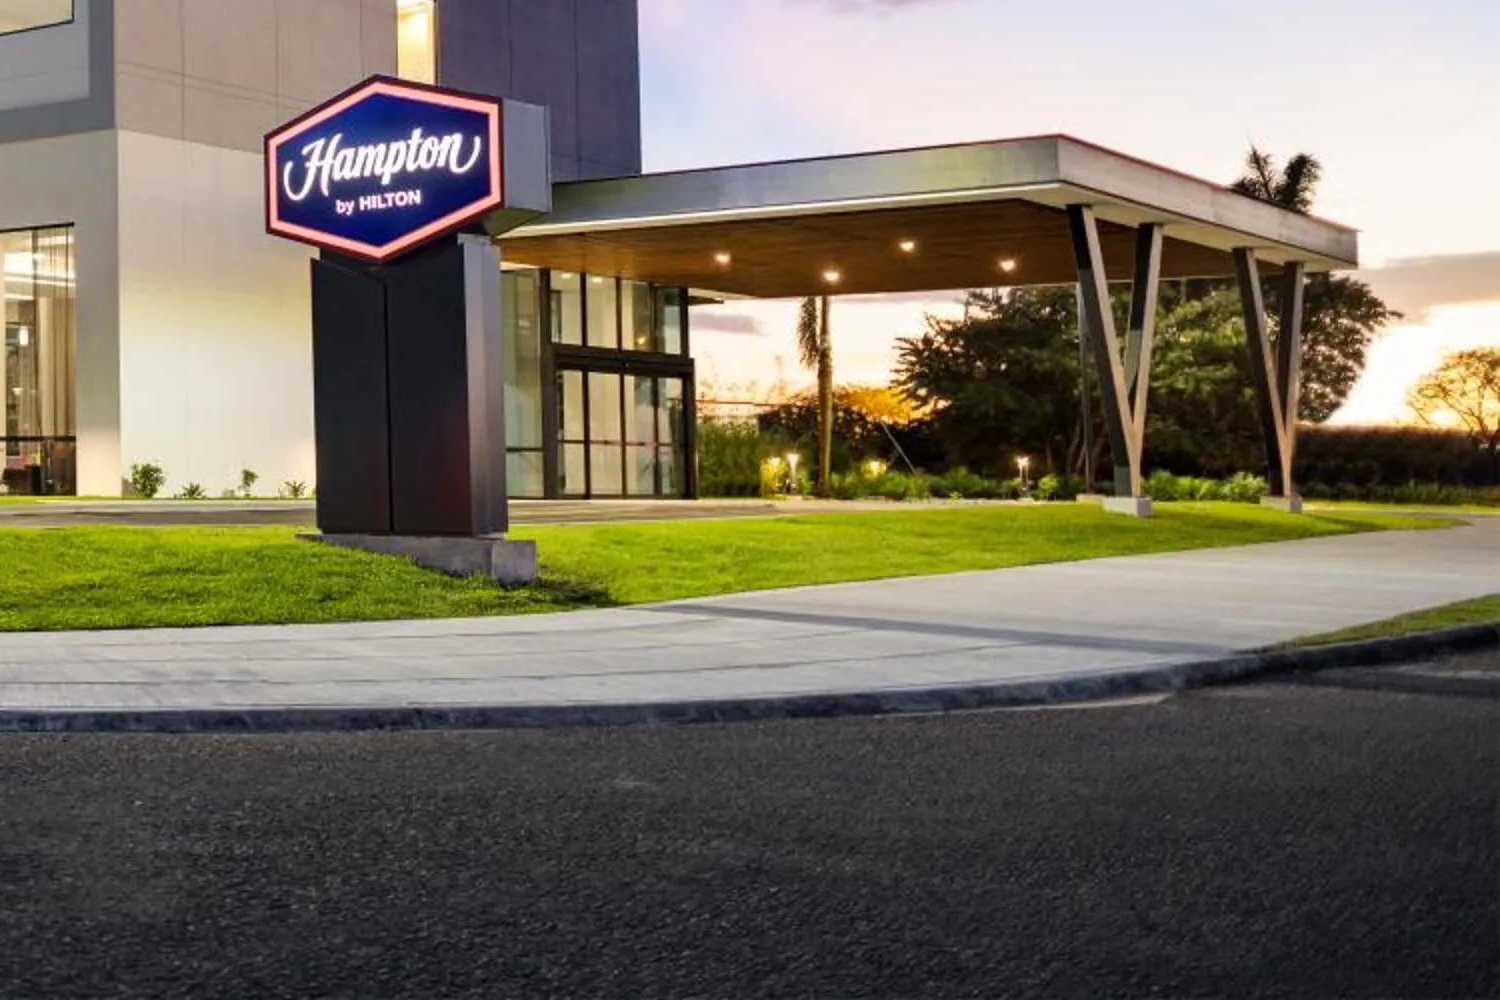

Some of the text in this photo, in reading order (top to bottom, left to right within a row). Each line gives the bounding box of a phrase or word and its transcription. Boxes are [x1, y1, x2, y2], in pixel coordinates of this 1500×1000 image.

[283, 127, 481, 201] Hampton
[335, 189, 421, 216] by HILTON
